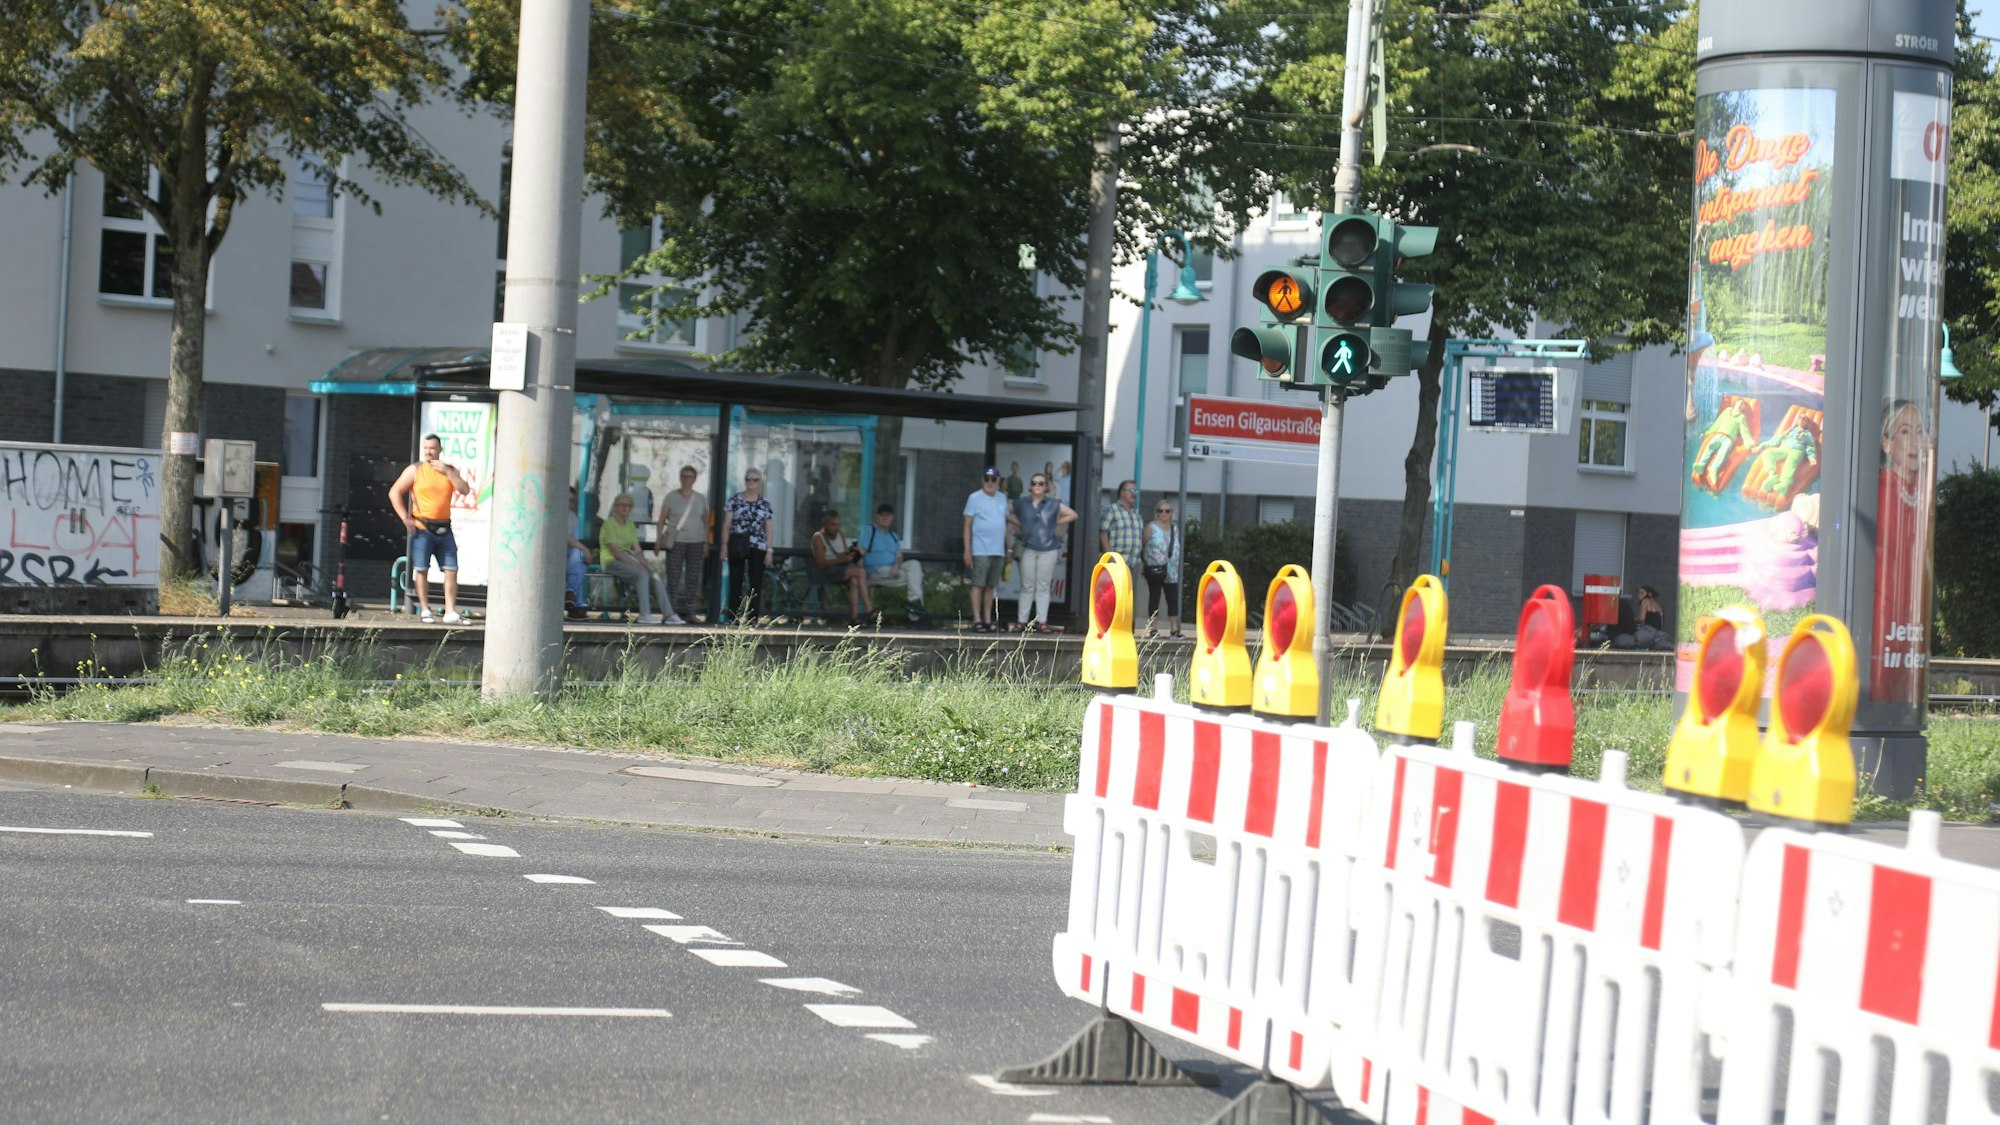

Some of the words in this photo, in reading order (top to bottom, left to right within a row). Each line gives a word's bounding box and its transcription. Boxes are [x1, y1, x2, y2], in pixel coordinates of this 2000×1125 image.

[1726, 124, 1811, 171] Dinge
[1699, 168, 1820, 224] entspannt
[1709, 219, 1814, 270] angehen
[437, 411, 481, 433] NRW
[1194, 408, 1234, 428] Ensen
[1238, 411, 1321, 435] Gilgaustraße
[439, 437, 477, 459] TAG
[3, 450, 135, 516] HOME
[1885, 621, 1924, 641] Jetzt
[1884, 646, 1901, 668] in
[1904, 647, 1925, 668] der
